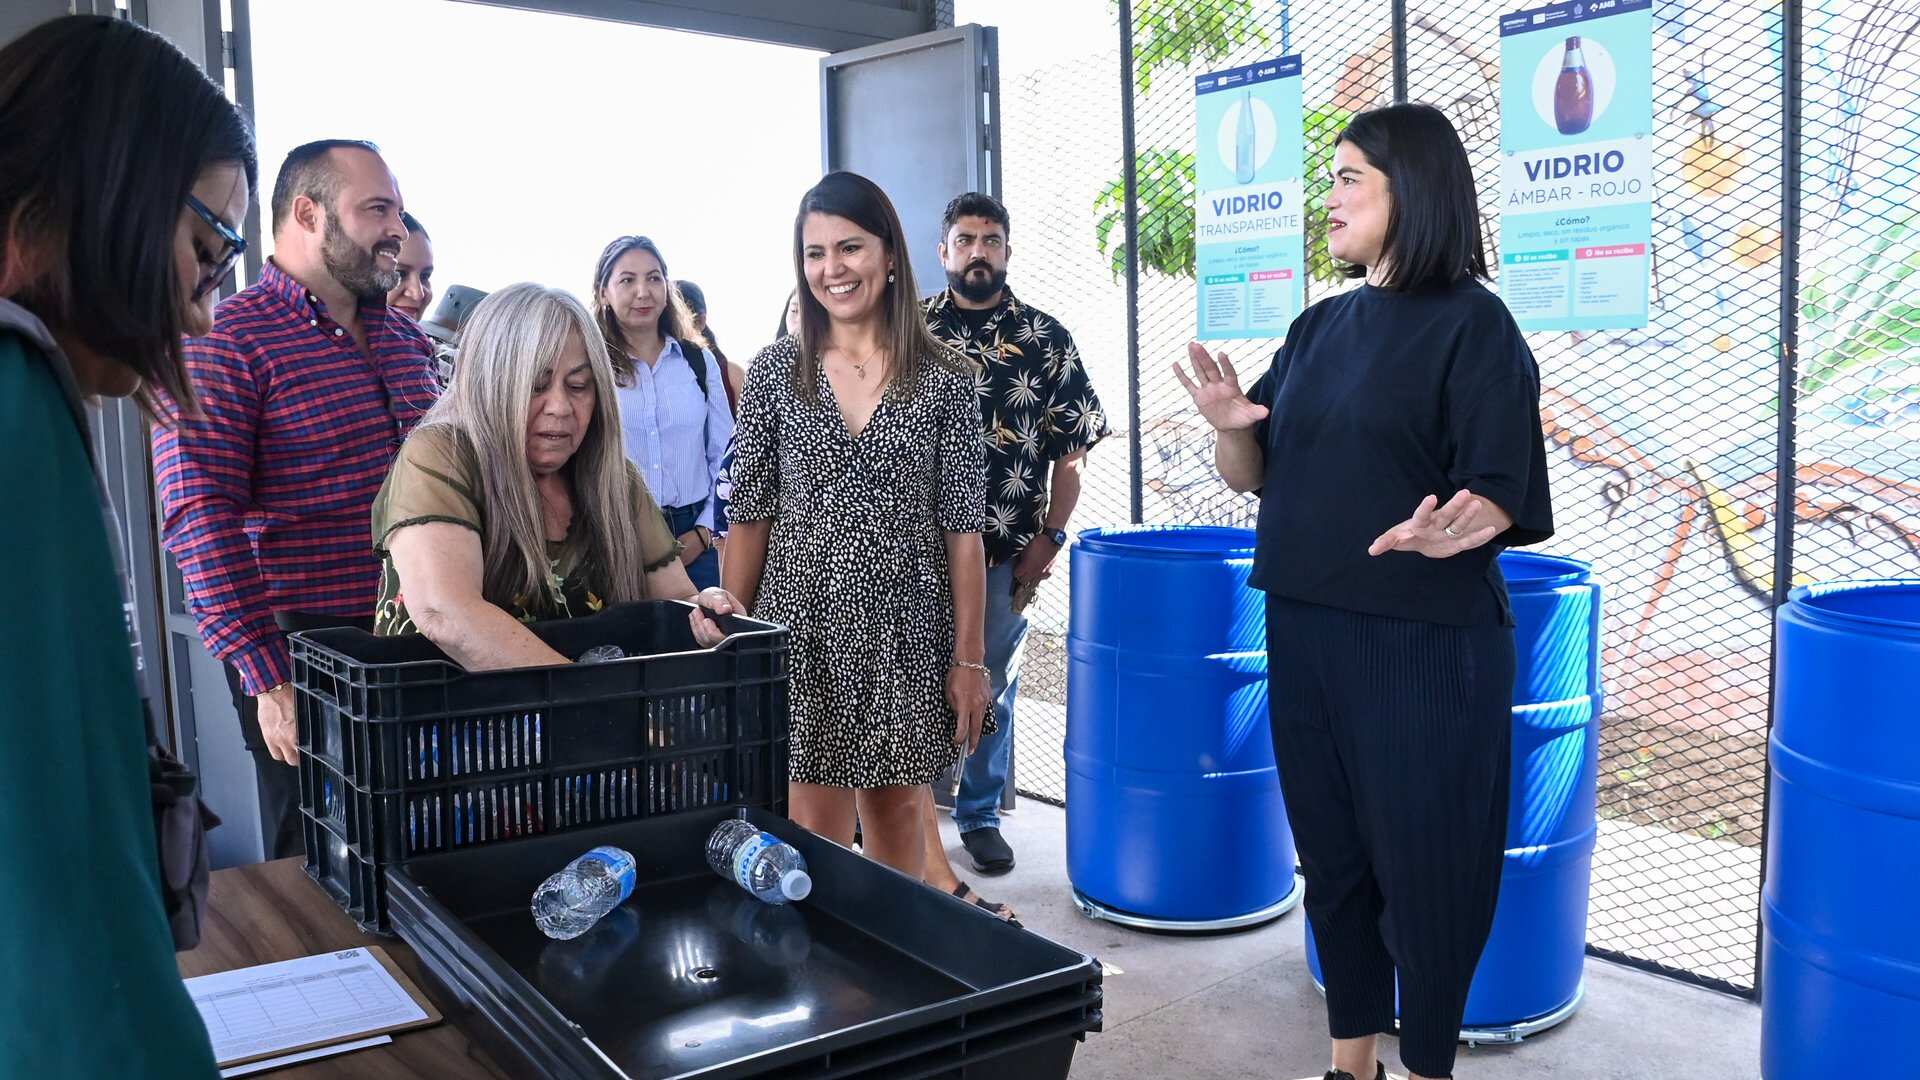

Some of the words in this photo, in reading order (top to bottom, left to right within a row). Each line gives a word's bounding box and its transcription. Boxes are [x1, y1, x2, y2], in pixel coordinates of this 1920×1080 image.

[1524, 150, 1624, 182] VIDRIO
[1212, 191, 1283, 217] VIDRIO
[1508, 186, 1572, 206] ÁMBAR
[1590, 178, 1641, 198] ROJO
[1199, 214, 1298, 237] TRANSPARENTE
[1555, 215, 1591, 226] ¿Cómo?
